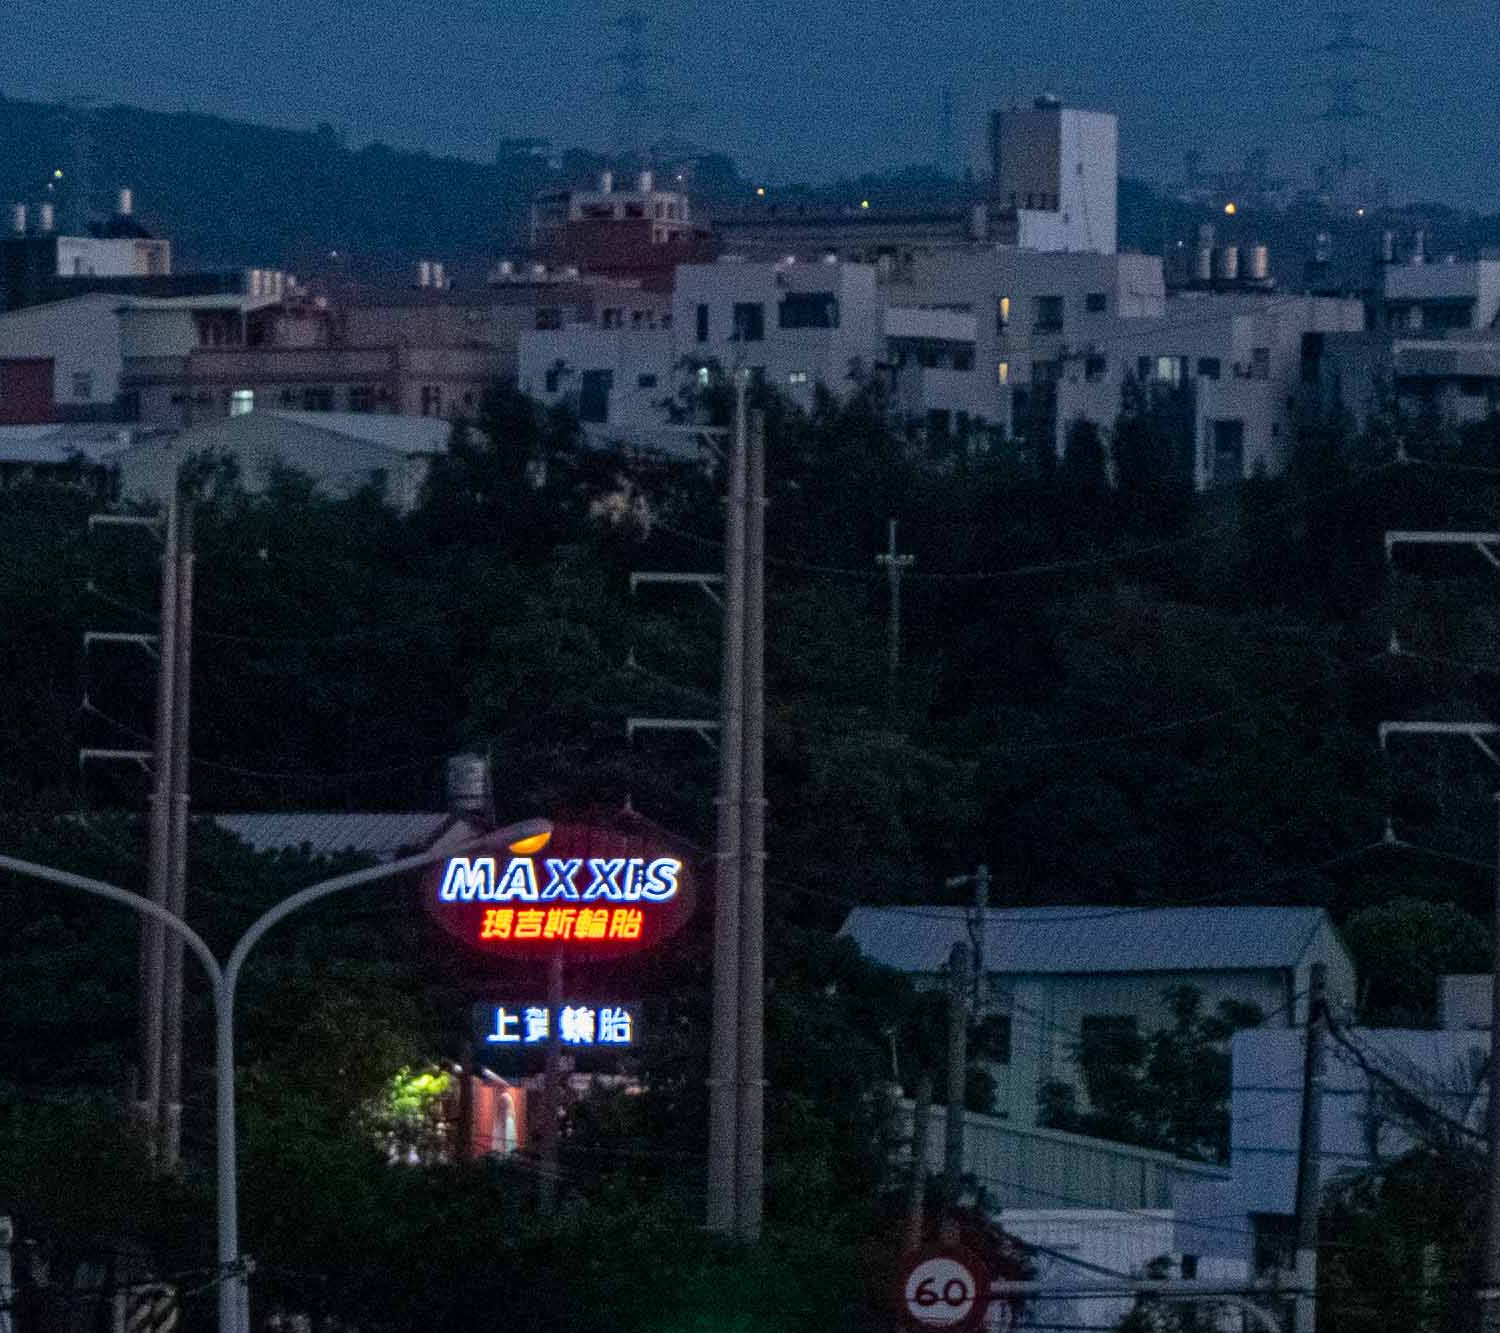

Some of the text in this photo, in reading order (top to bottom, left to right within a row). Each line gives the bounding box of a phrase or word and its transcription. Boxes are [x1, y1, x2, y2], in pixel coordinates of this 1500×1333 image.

[440, 856, 682, 903] MAXXIS
[480, 908, 643, 940] 瑪吉斯輪胎
[916, 1278, 967, 1307] 60
